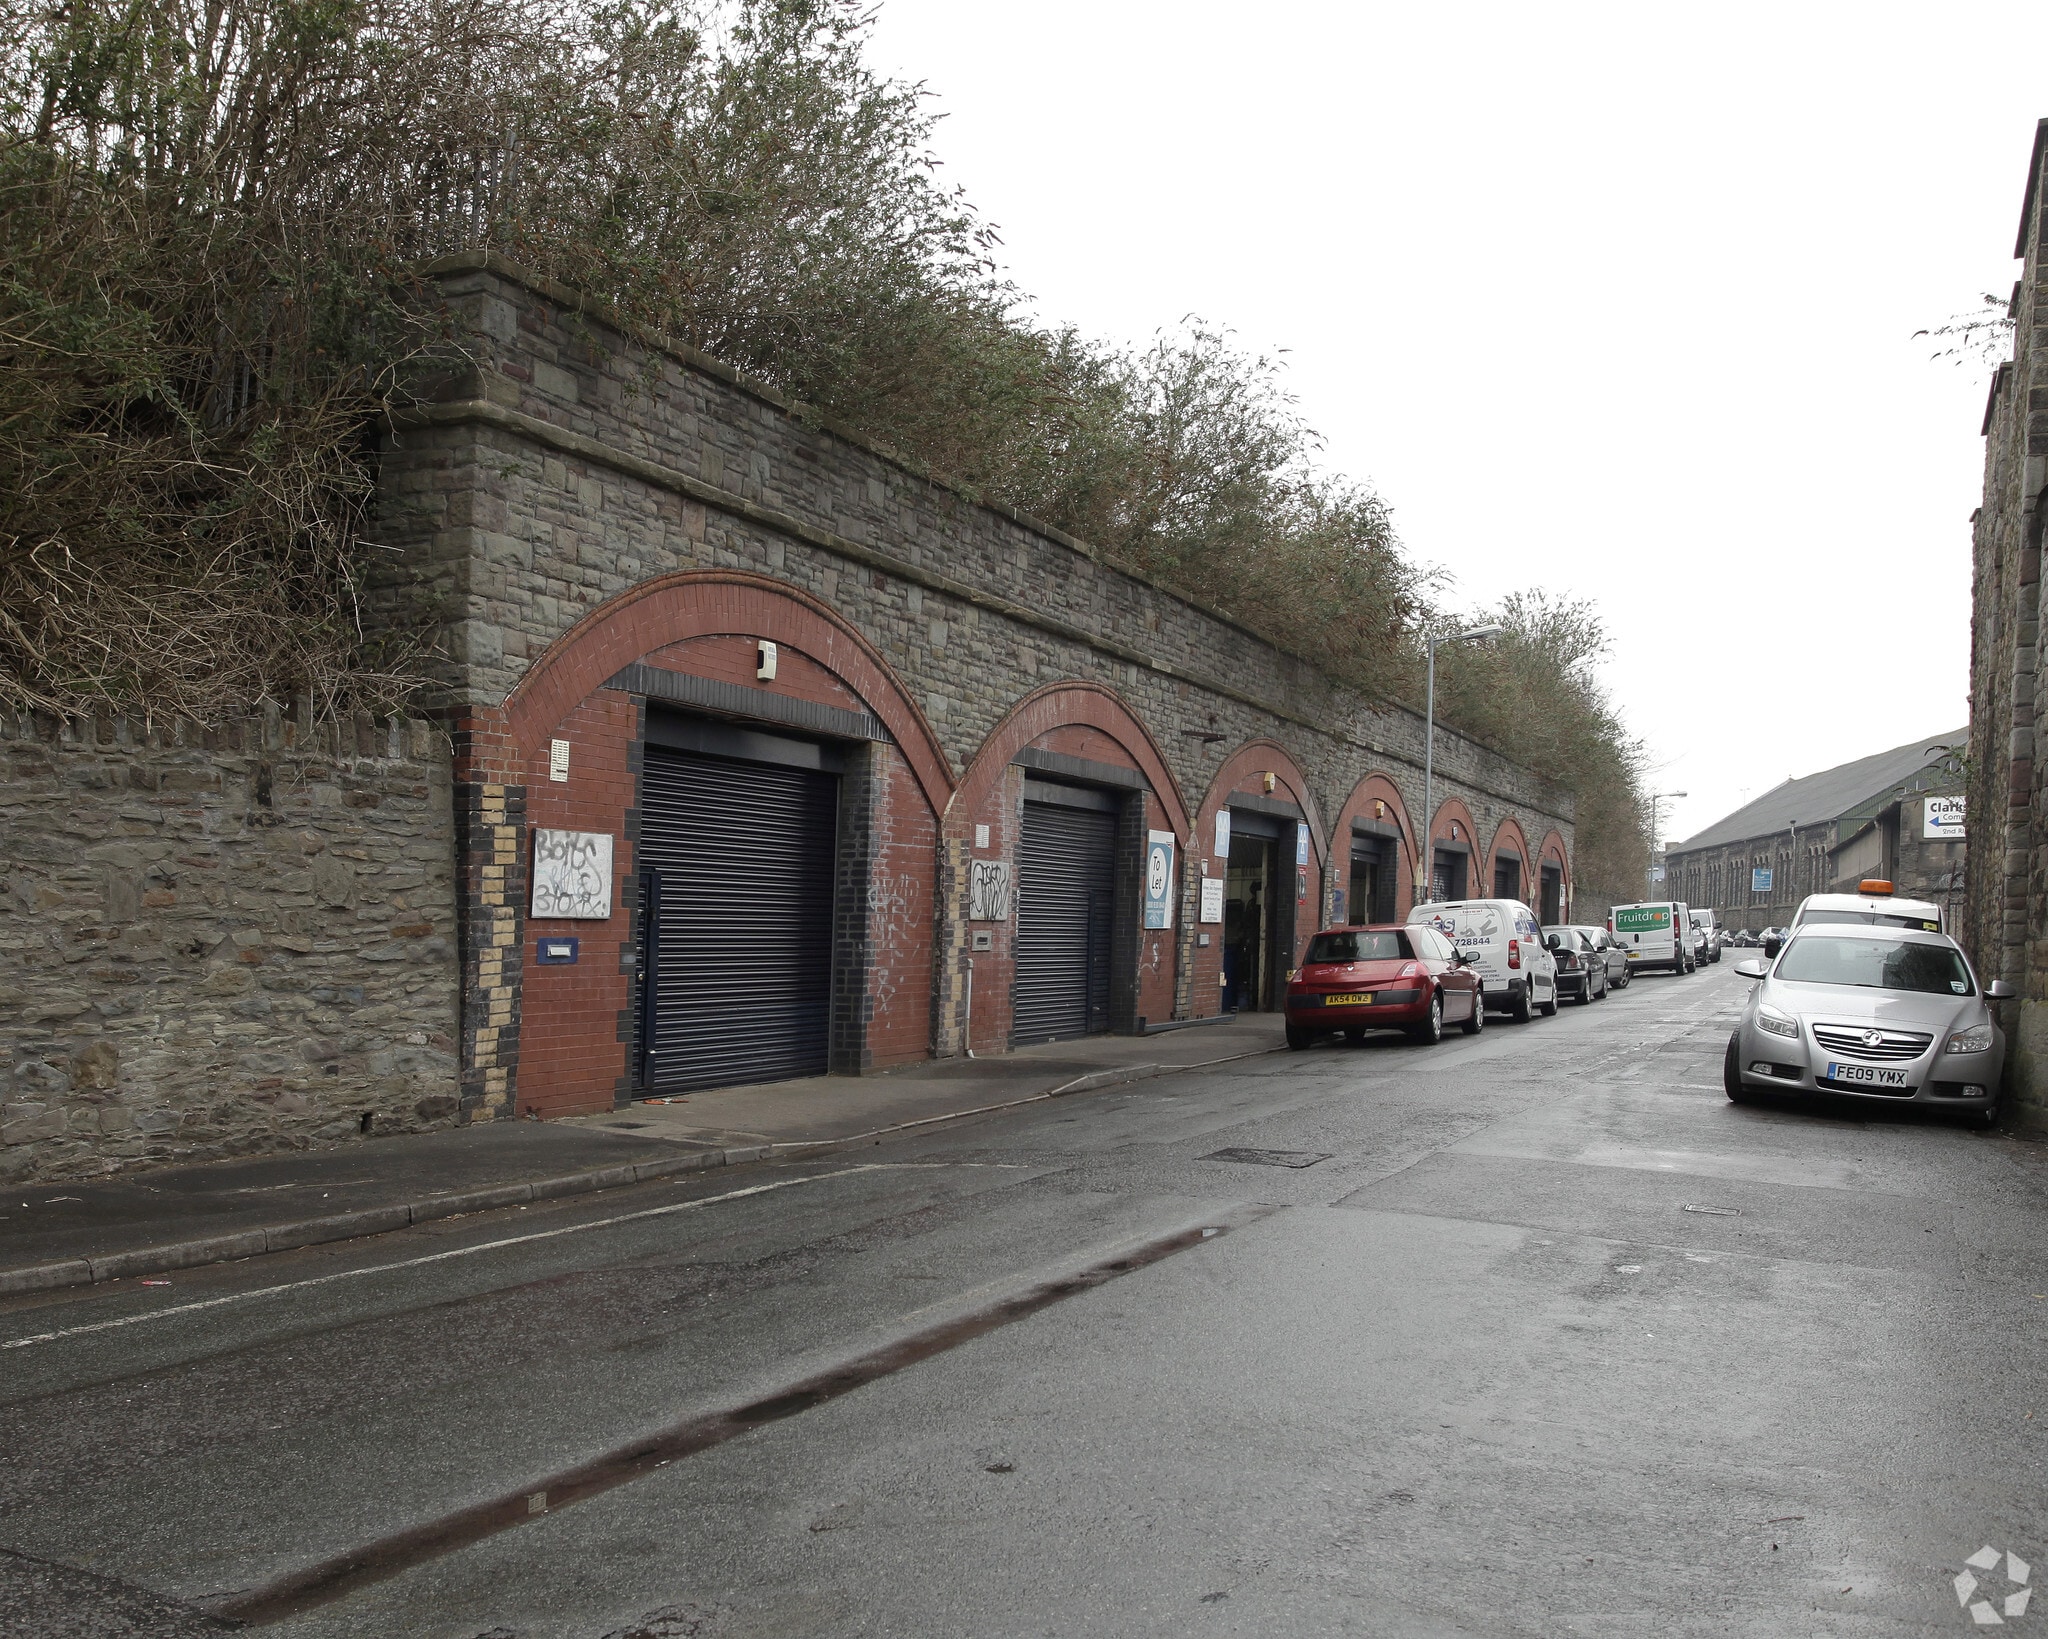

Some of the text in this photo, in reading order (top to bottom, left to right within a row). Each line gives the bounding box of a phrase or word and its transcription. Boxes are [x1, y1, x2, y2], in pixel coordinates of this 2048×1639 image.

[1930, 802, 1966, 813] Clark
[1153, 855, 1161, 871] To
[1151, 874, 1162, 890] Let
[1455, 937, 1490, 946] 728844
[1837, 1065, 1906, 1085] FE09 YMX
